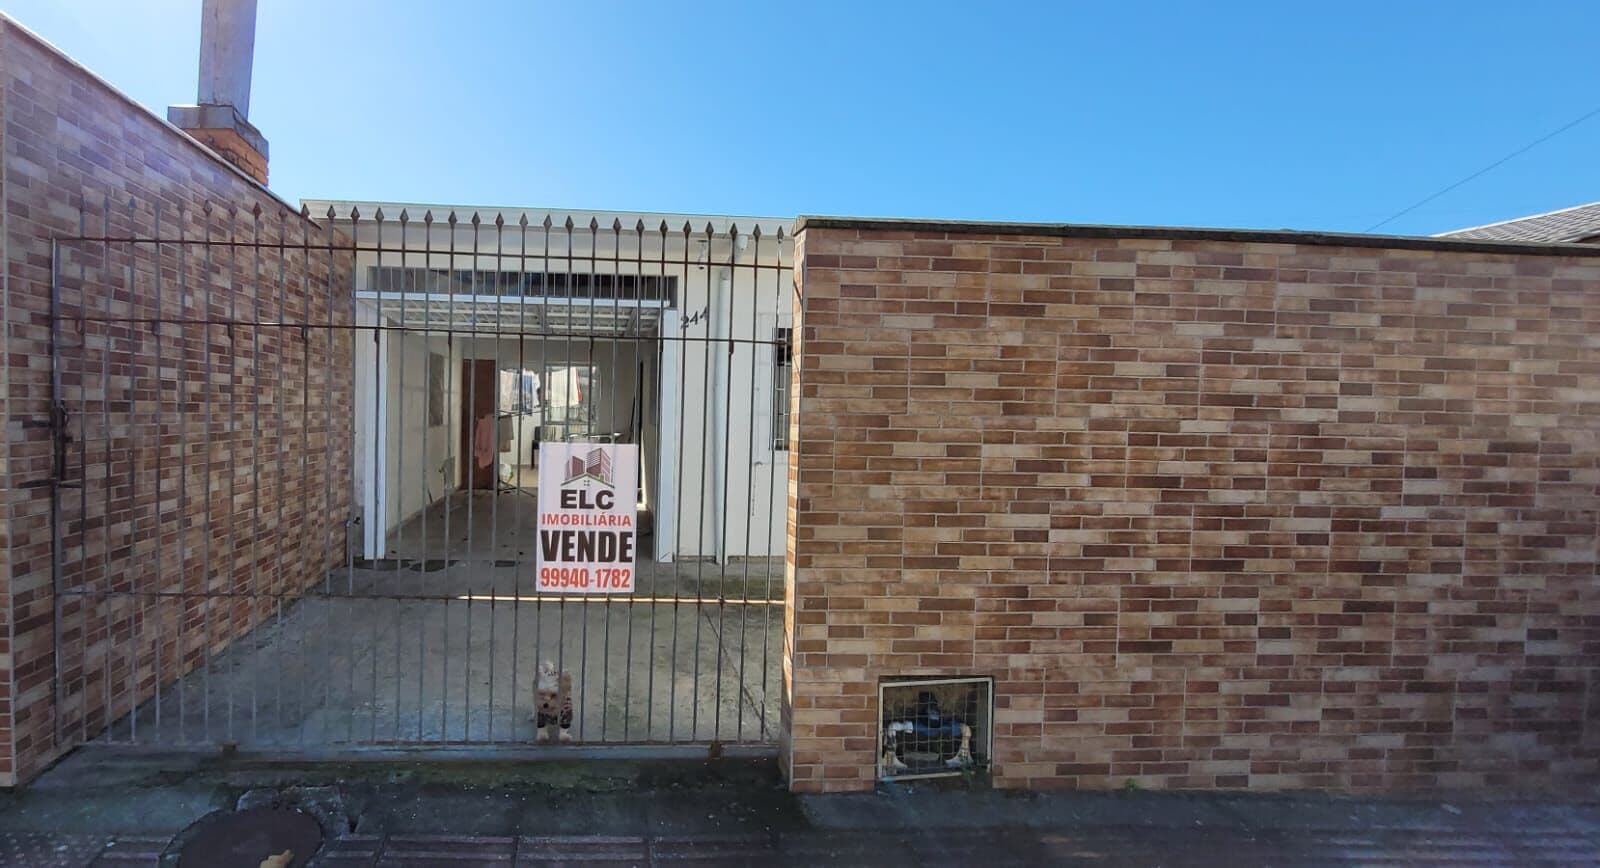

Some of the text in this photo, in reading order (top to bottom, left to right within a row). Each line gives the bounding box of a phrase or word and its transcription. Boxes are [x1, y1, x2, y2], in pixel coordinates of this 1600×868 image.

[560, 489, 615, 510] ELC
[541, 512, 632, 527] IMOBILIÁRIA
[540, 530, 633, 563] VENDE
[540, 567, 631, 588] 99940-1782
